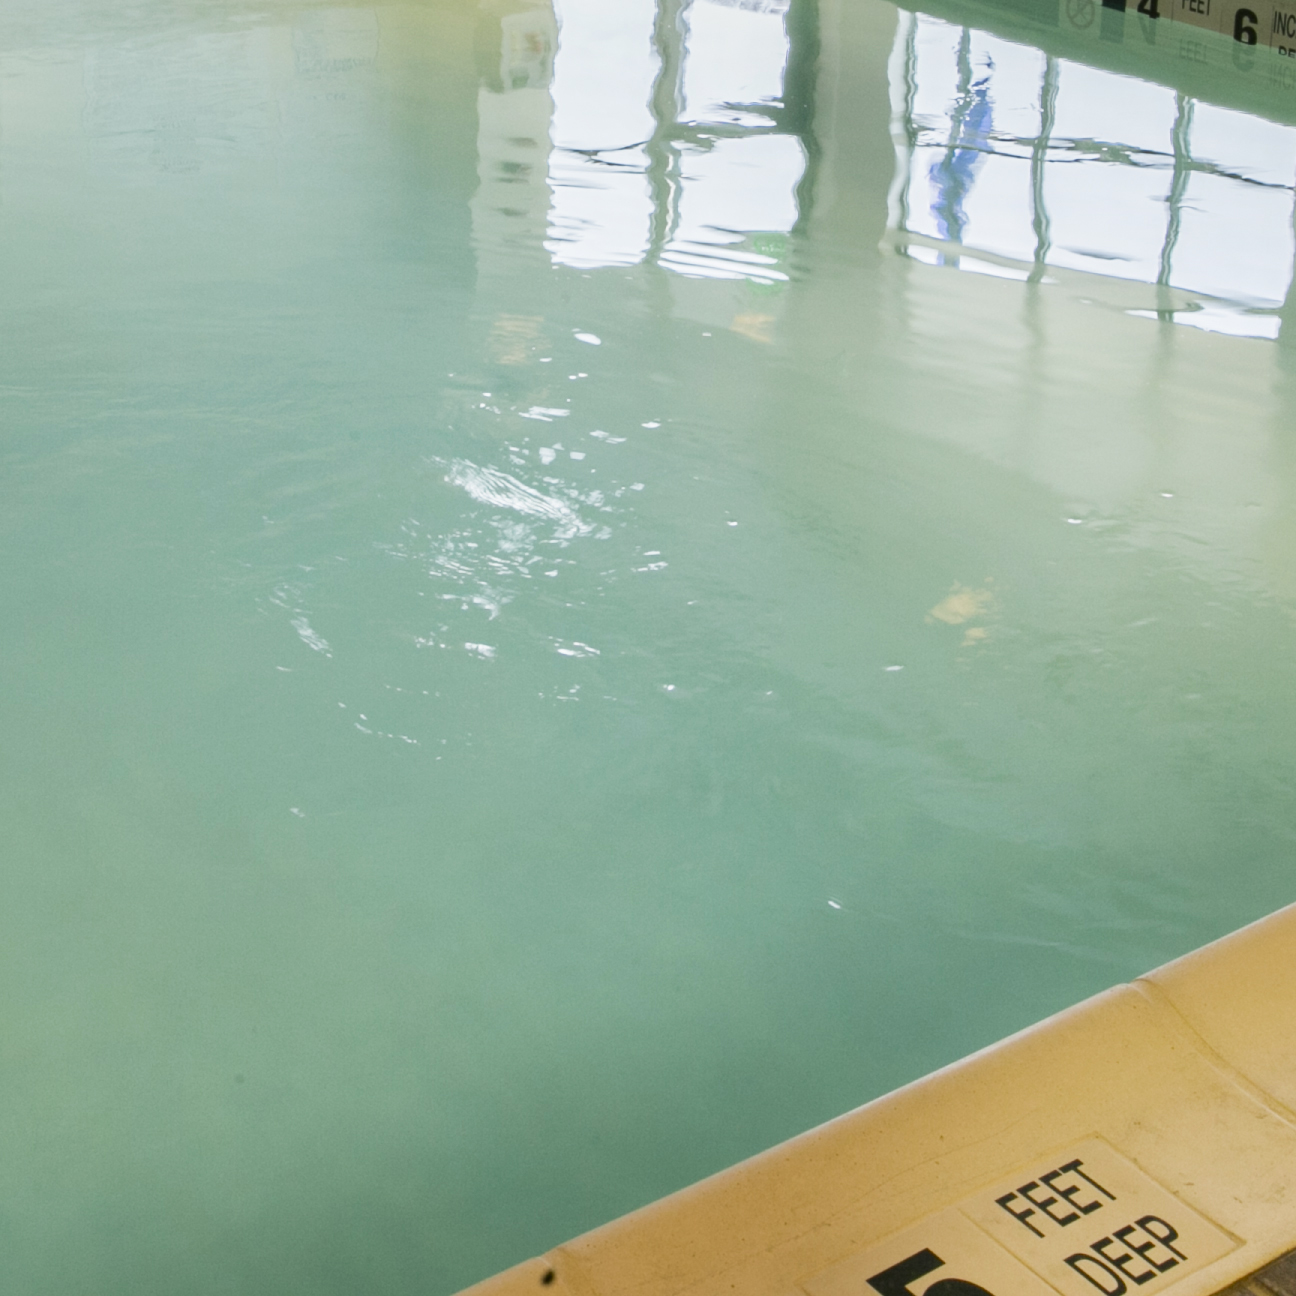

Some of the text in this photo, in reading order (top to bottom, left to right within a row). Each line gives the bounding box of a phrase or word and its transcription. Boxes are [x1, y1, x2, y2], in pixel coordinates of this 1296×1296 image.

[1233, 8, 1258, 45] 6
[994, 1158, 1117, 1238] FEET
[1063, 1214, 1188, 1296] DEEP
